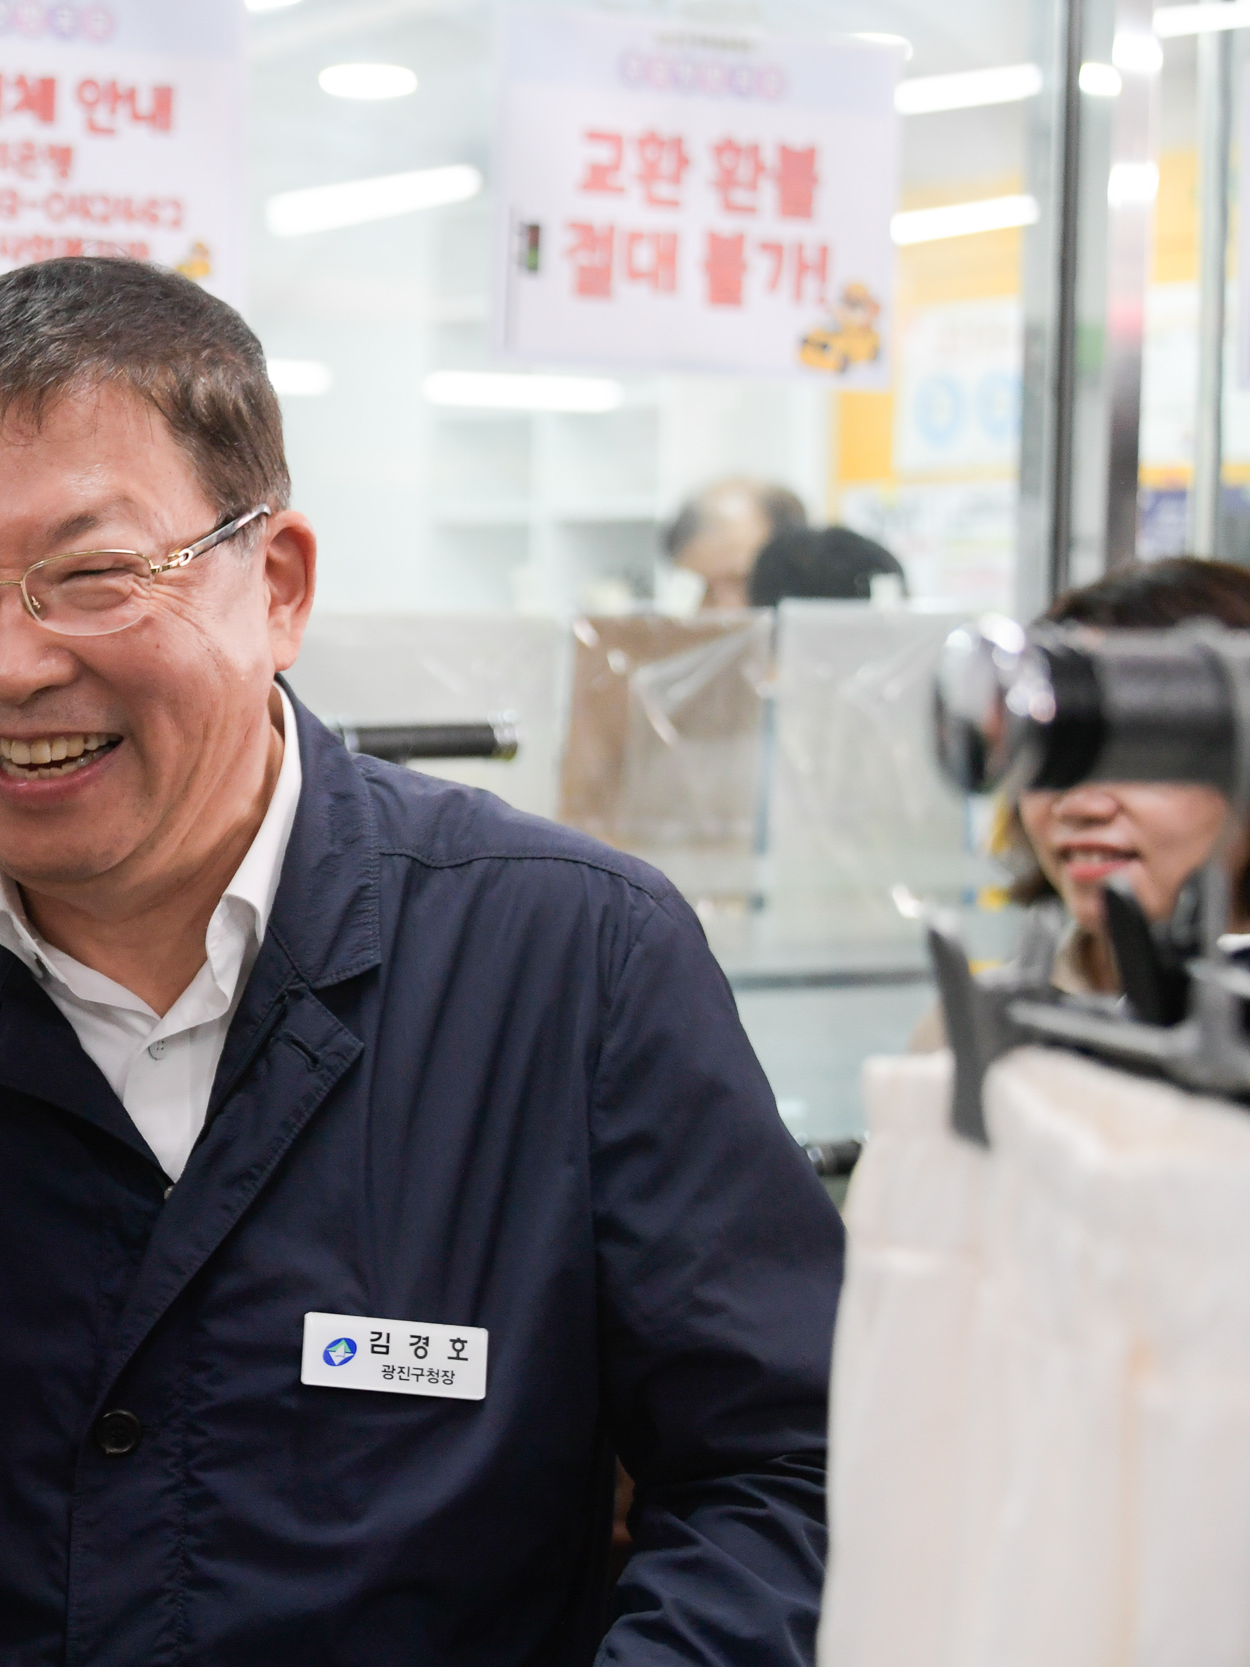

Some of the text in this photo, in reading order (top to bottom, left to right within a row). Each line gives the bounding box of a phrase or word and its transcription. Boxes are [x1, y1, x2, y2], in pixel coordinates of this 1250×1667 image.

[76, 78, 175, 136] 안내
[578, 129, 820, 221] 교환 환불
[381, 1365, 455, 1385] 광진구청장
